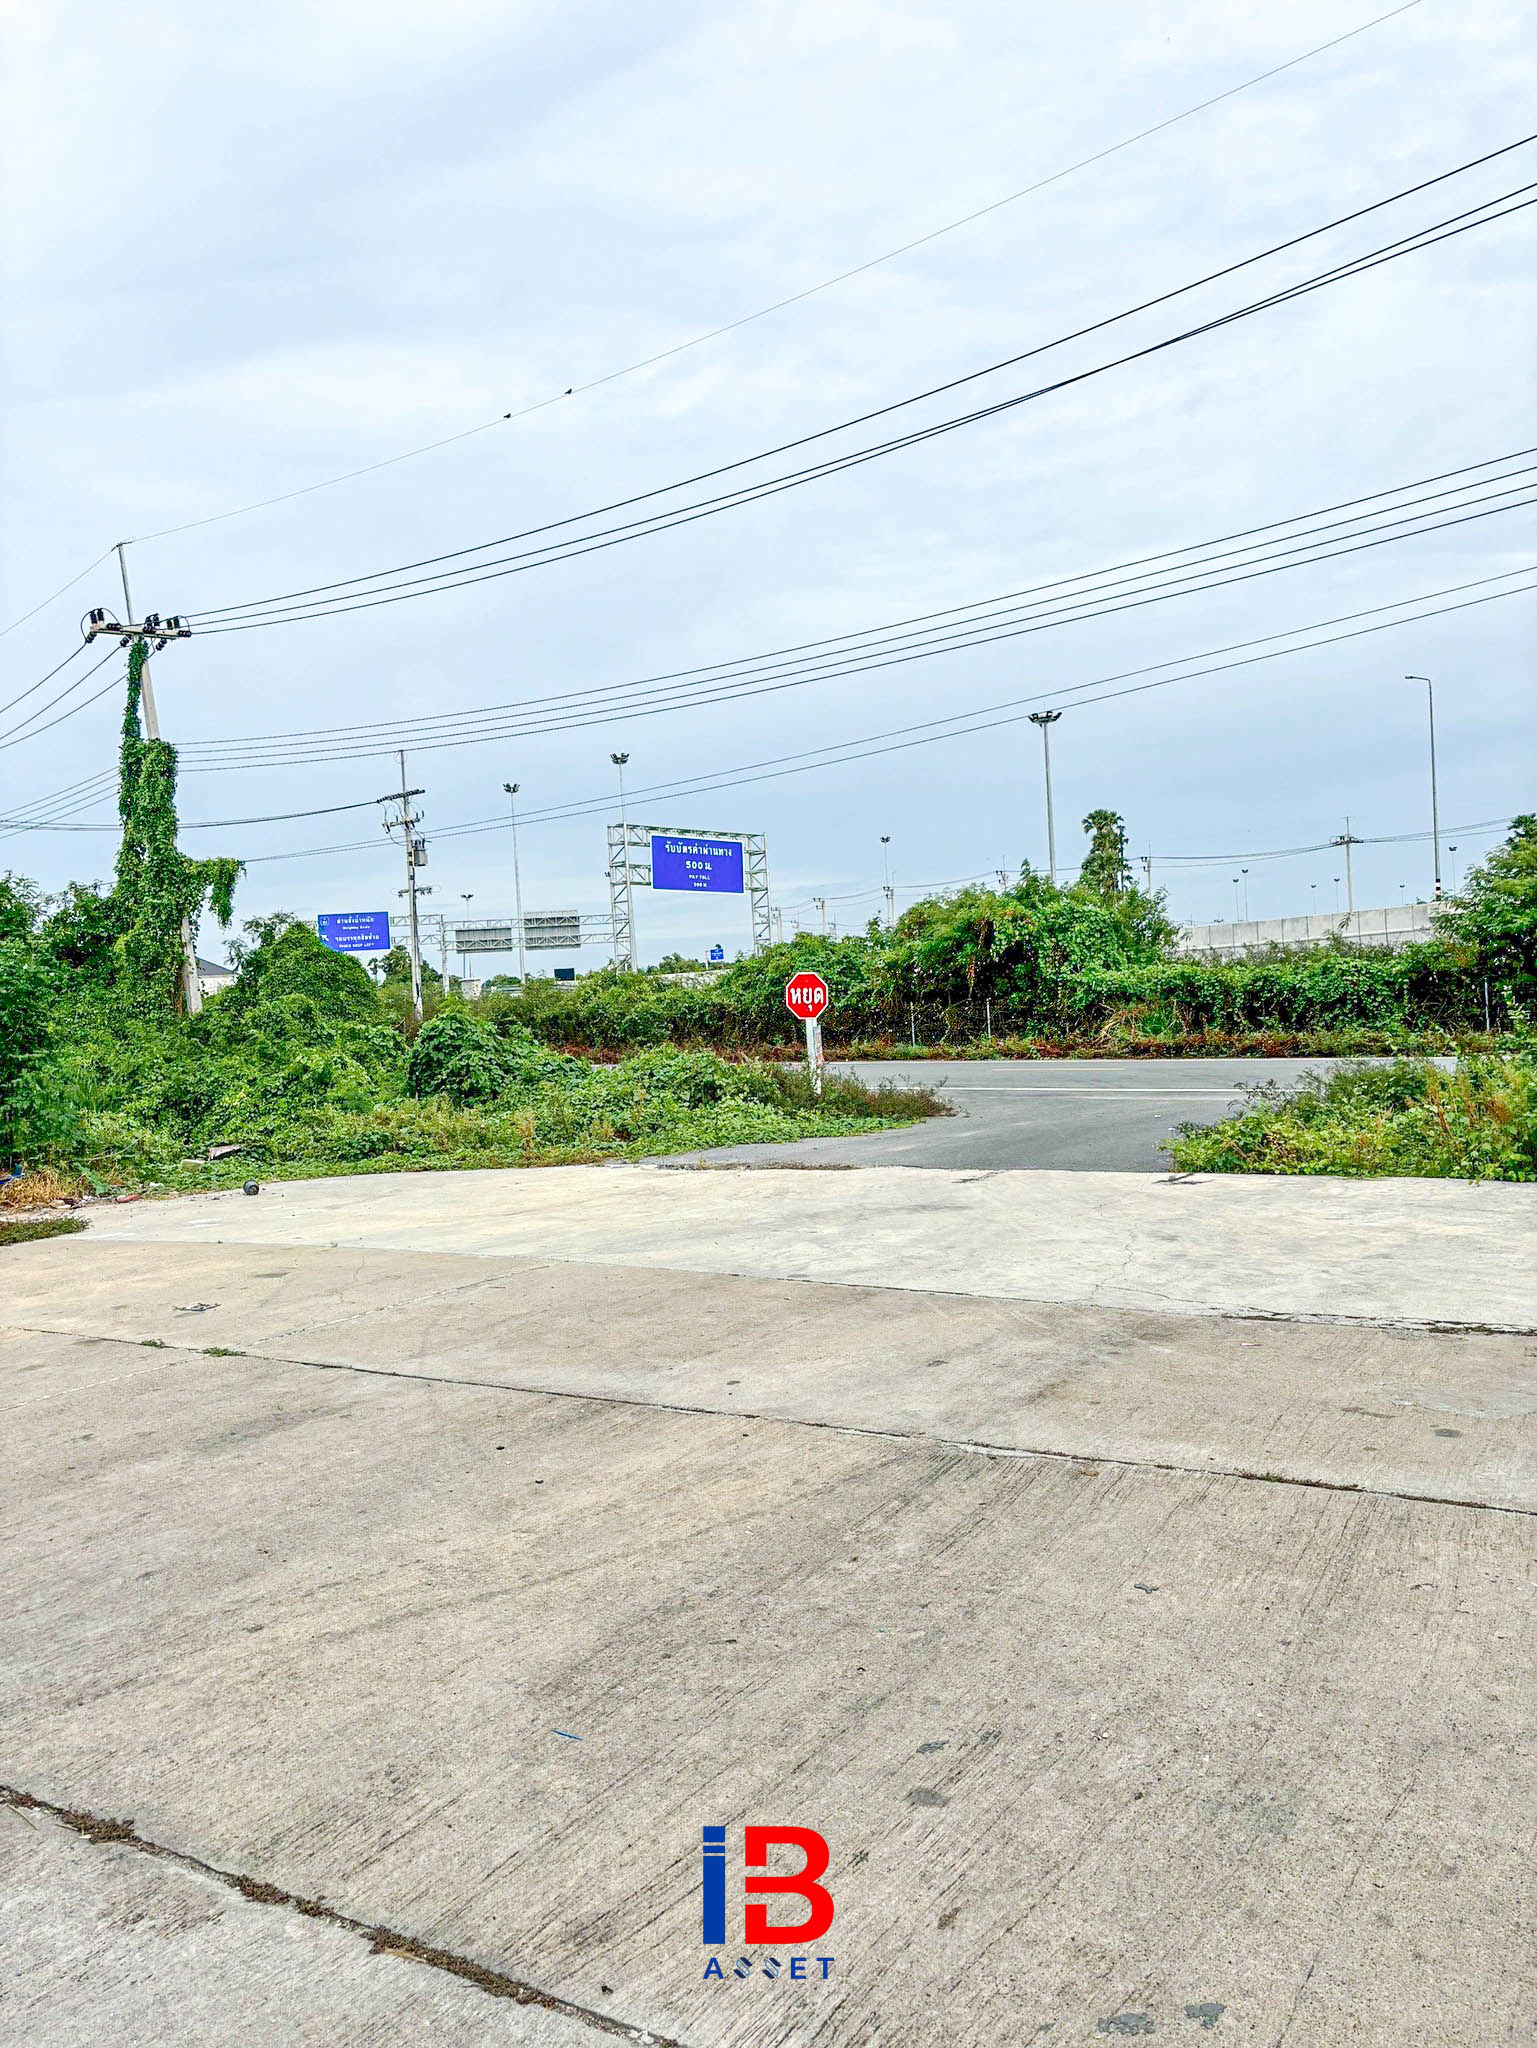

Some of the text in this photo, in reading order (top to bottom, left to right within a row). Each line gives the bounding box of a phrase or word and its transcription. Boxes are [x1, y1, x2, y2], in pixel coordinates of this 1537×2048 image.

[665, 840, 732, 856] รับบัตรค่าผ่านทาง
[685, 860, 703, 870] 500
[790, 987, 824, 1012] หยุด
